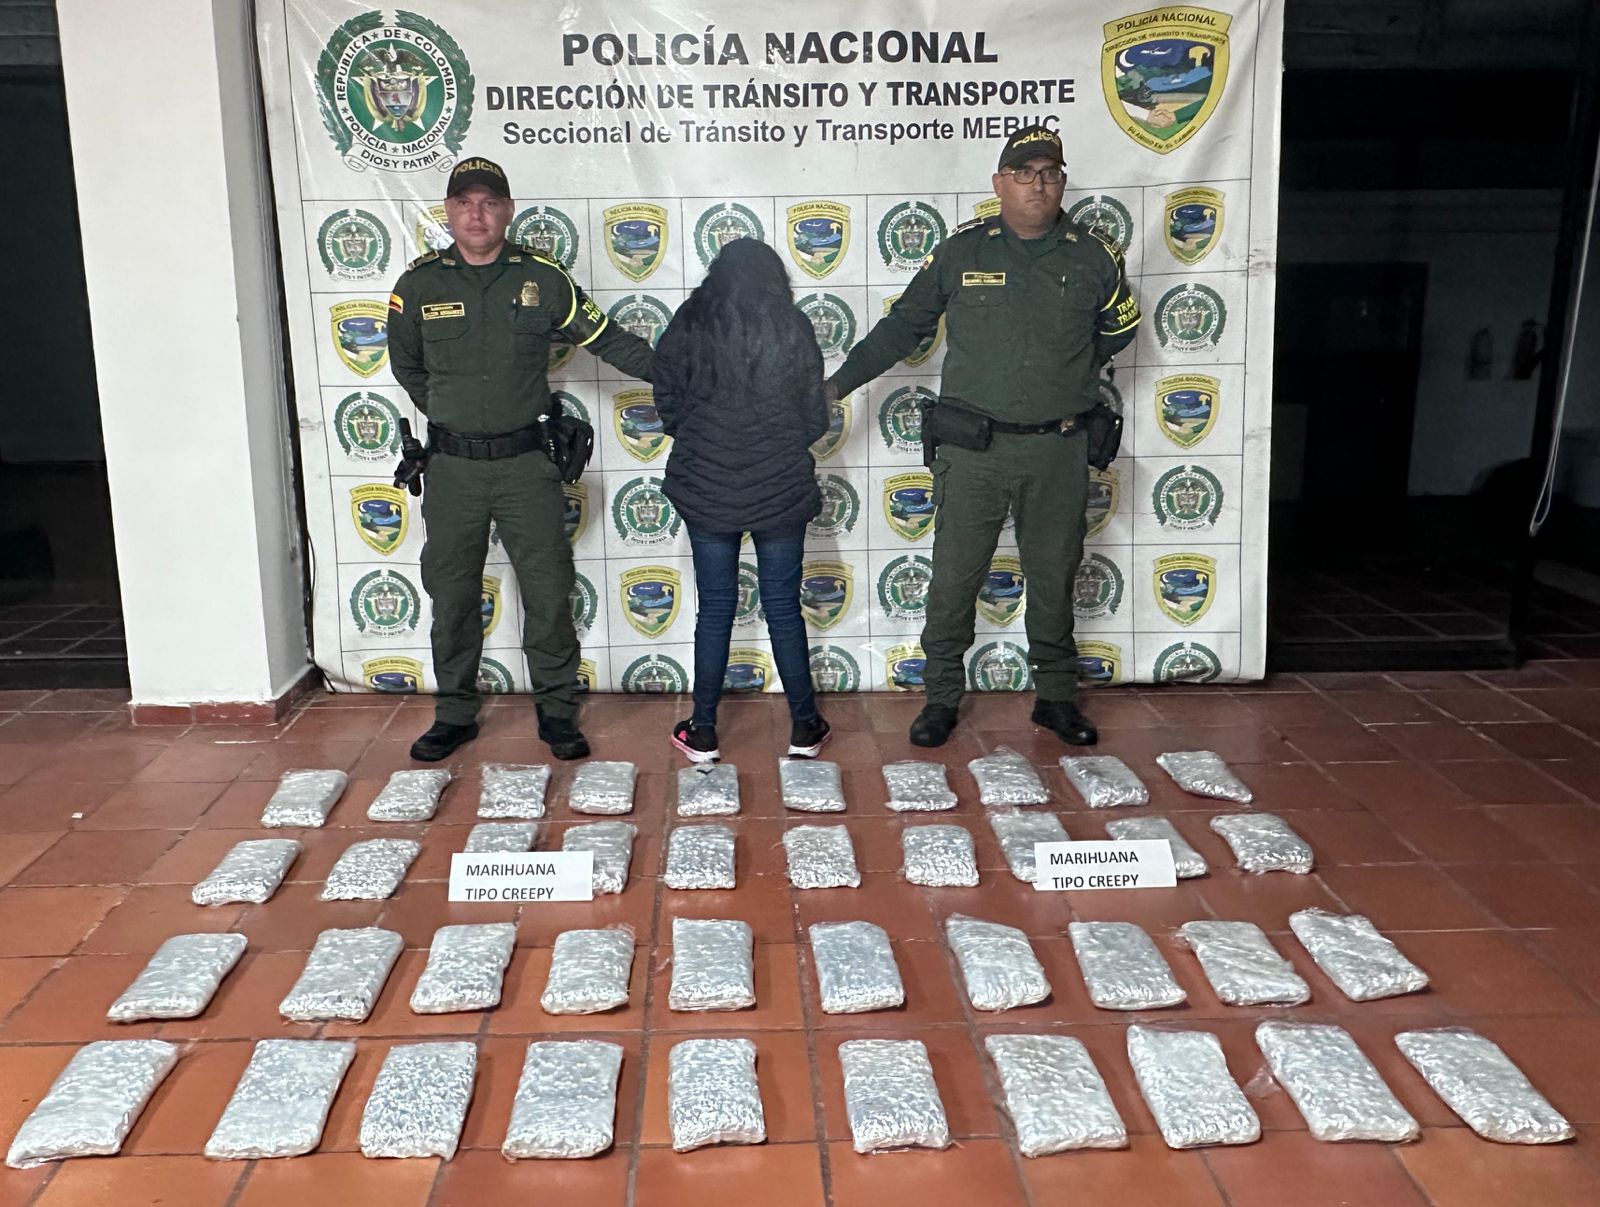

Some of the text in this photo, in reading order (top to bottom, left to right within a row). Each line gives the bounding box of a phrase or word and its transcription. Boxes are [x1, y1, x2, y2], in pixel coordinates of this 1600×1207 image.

[1116, 12, 1217, 32] POLICIA NACIONAL
[563, 25, 998, 67] POLICÍA NACIONAL
[337, 29, 456, 102] REPUBLICA DE COLOMBIA
[486, 77, 1075, 111] DIRECCIÓN DE TRÁNSITO Y TRANSPORTE
[345, 114, 452, 154] POLICIA NACIONAL
[503, 120, 631, 145] Seccional
[640, 122, 671, 144] de
[679, 119, 785, 144] Tránsito
[793, 123, 808, 147] y
[816, 118, 954, 145] Transporte
[403, 150, 441, 169] PATRIA
[1050, 851, 1139, 866] MARIHUANA
[466, 863, 556, 877] MARIHUANA
[1052, 874, 1139, 889] TIPO CREEPY
[465, 887, 555, 900] TIPO CREEPY
